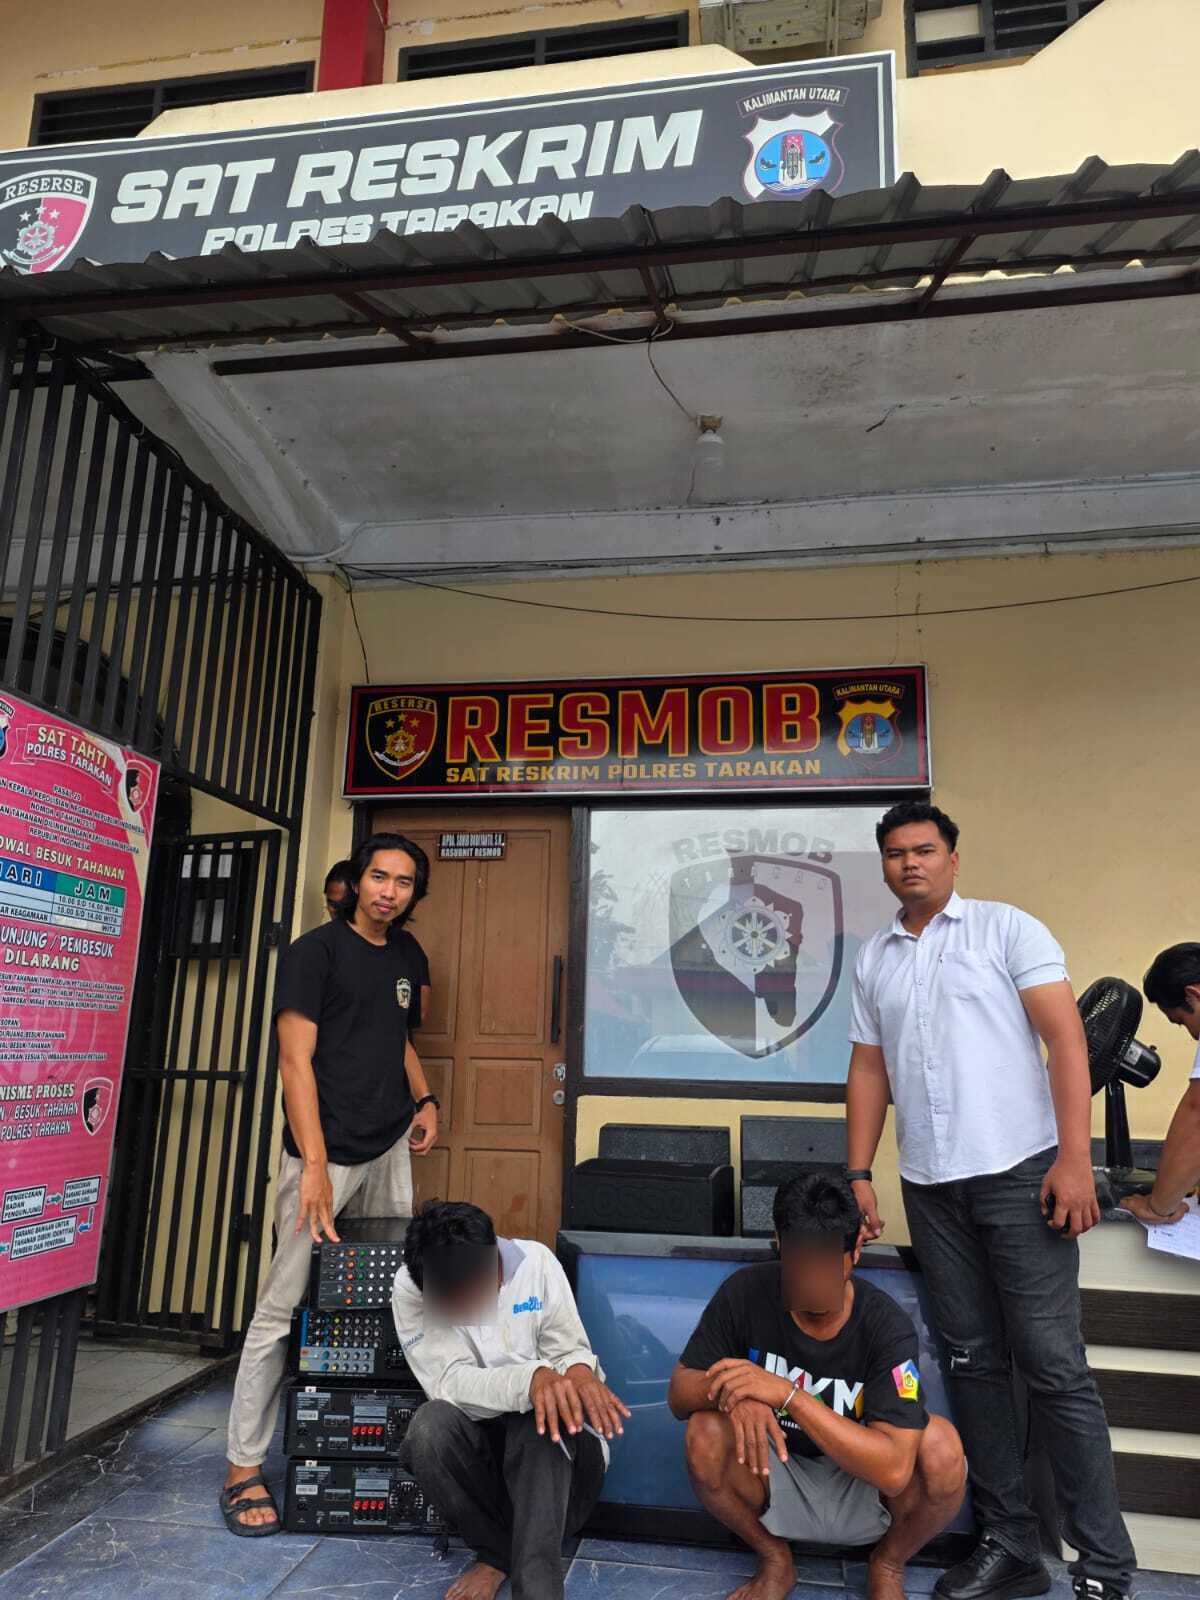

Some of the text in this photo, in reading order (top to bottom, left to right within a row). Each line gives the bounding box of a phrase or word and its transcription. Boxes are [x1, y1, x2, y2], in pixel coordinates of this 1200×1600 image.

[743, 87, 841, 112] KALIMANTAN UTARA
[111, 109, 703, 224] SAT RESKRIM
[4, 177, 85, 201] RESERSE
[200, 191, 594, 256] POLRES TARAKAN
[879, 684, 900, 695] UTARA
[373, 698, 433, 712] RESERSE
[446, 683, 821, 763] RESMOB
[38, 726, 108, 769] SAT TAHTI
[27, 743, 112, 786] POLRES TARAKAN
[446, 759, 821, 783] SAT RESKRIM POLRES TARAKAN
[671, 828, 835, 864] RESMOB
[36, 846, 72, 868] BESUK
[77, 857, 125, 881] TAHANAN
[74, 881, 112, 901] JAM
[0, 926, 48, 949] UNJUNG
[60, 935, 114, 958] PEMBESUK
[5, 948, 80, 971] DILARANG
[35, 1083, 75, 1099] PROSES
[14, 1103, 41, 1120] BESUK
[44, 1101, 79, 1118] TAHANAN
[1, 1120, 71, 1141] POLRES TARAKAN
